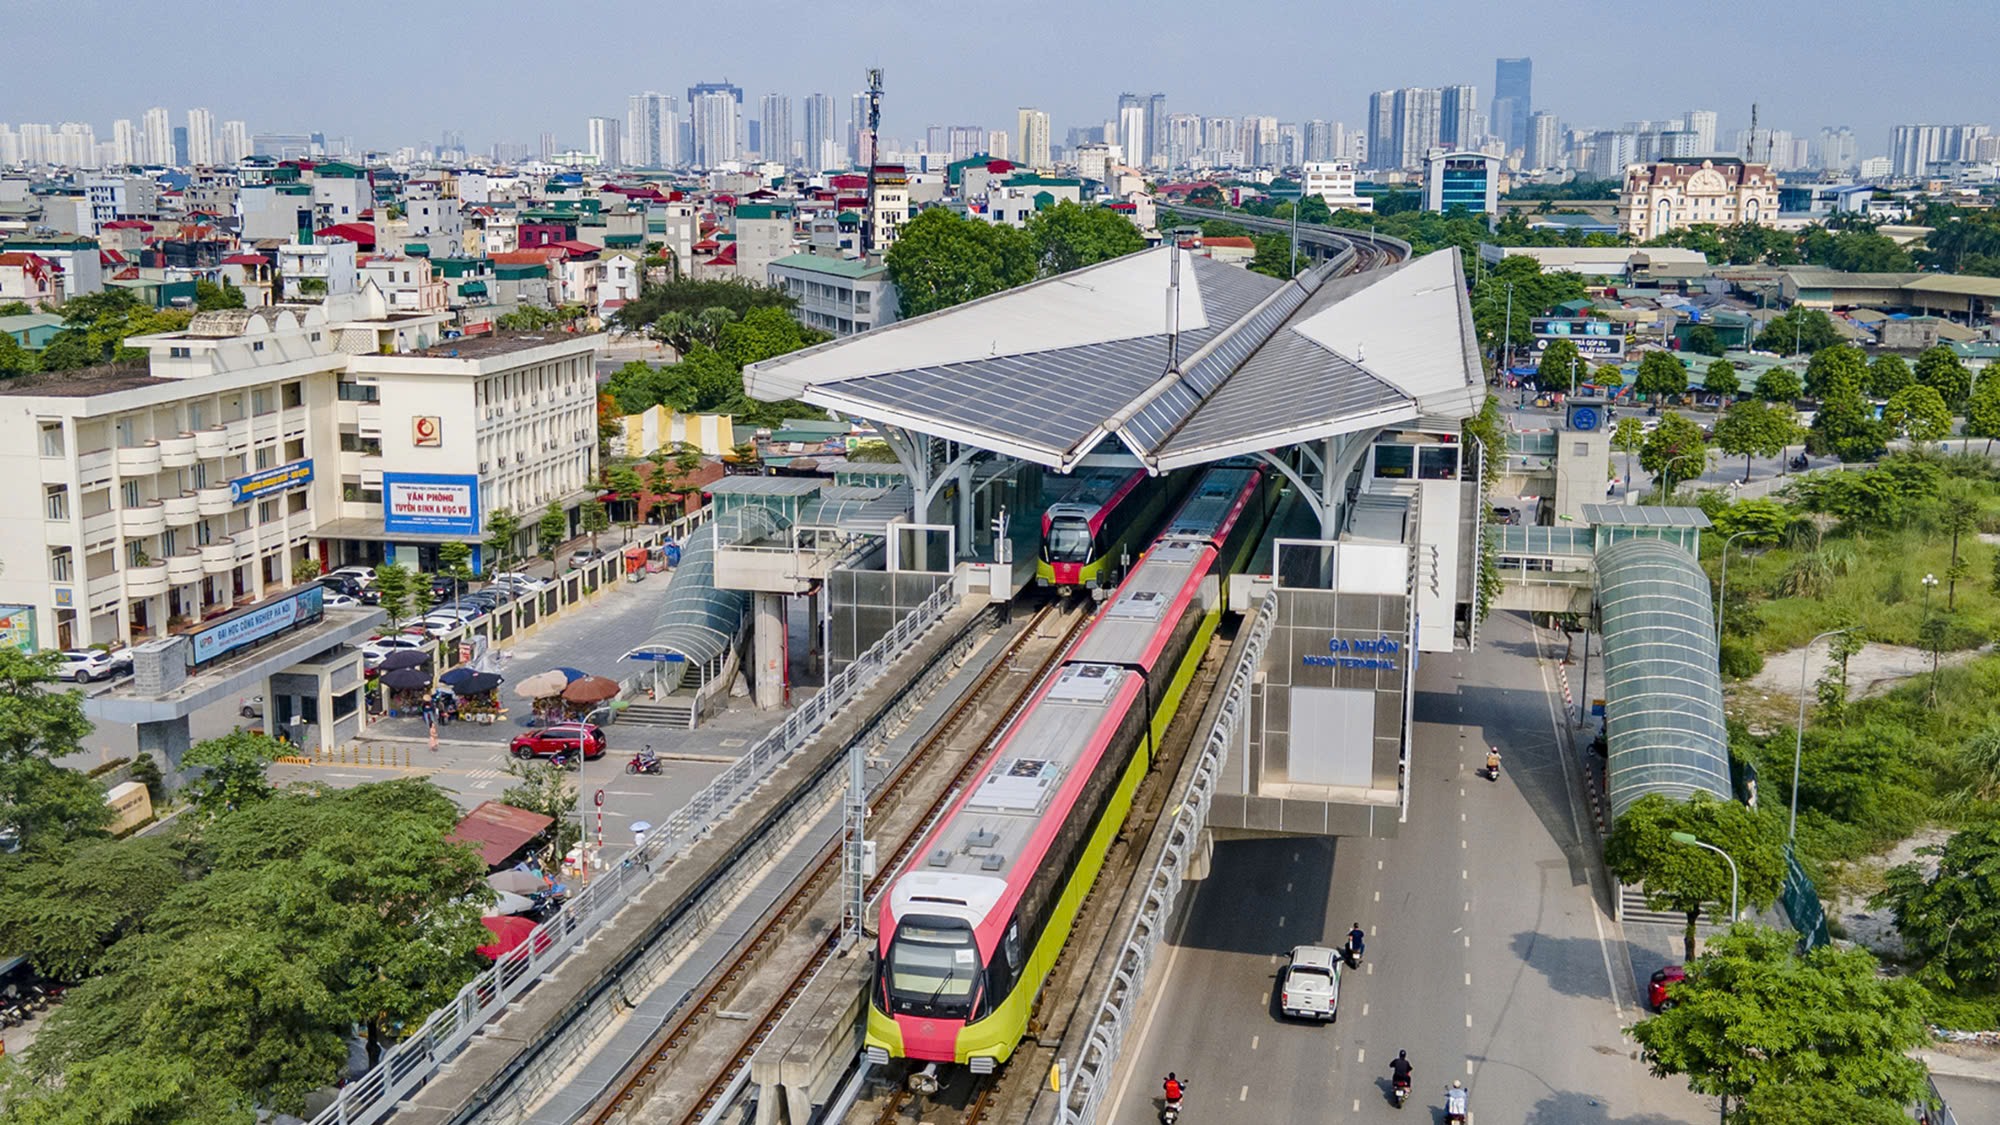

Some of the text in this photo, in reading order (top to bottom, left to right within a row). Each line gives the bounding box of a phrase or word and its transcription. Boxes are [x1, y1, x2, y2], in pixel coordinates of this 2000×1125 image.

[407, 491, 454, 502] VĂN PHÒNG
[442, 505, 456, 515] HỌC
[458, 505, 467, 515] VỤ
[1329, 633, 1399, 654] GA NHỔN
[1303, 655, 1399, 670] NHON TERMINAL
